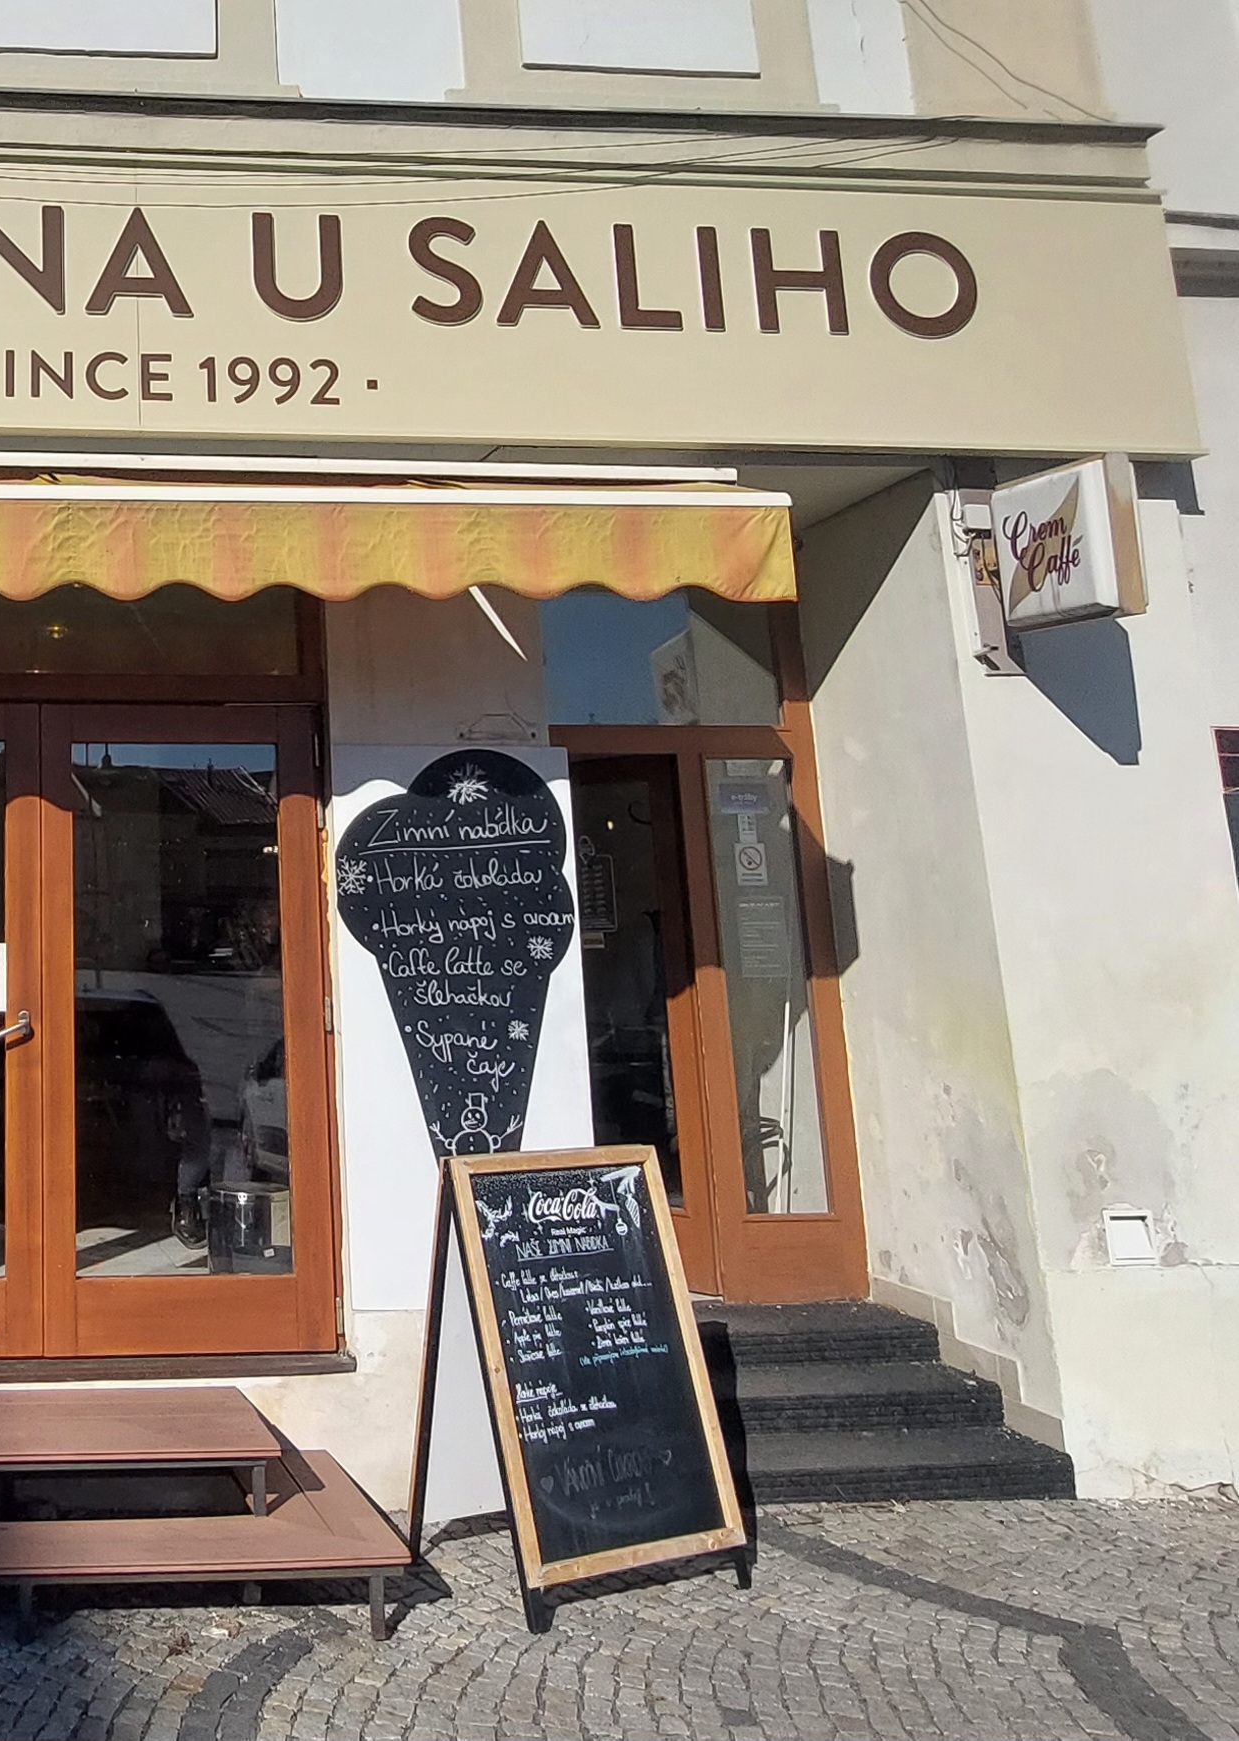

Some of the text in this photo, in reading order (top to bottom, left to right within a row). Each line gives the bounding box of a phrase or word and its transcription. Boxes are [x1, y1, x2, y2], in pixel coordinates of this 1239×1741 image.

[251, 211, 344, 323] U
[407, 215, 979, 339] SALIHO
[198, 355, 341, 406] 1992
[1002, 511, 1067, 561] Crem
[367, 802, 548, 848] Zimní nabídka
[373, 857, 543, 895] Horká čokoláda
[380, 907, 444, 943] Horký
[447, 905, 497, 941] nápoj
[501, 912, 516, 929] s
[388, 946, 528, 978] Caffe latte se
[413, 979, 512, 1007] šlehačkou
[416, 1019, 498, 1063] Sypané
[466, 1051, 516, 1092] čaje
[528, 1187, 598, 1224] Coca-Cola
